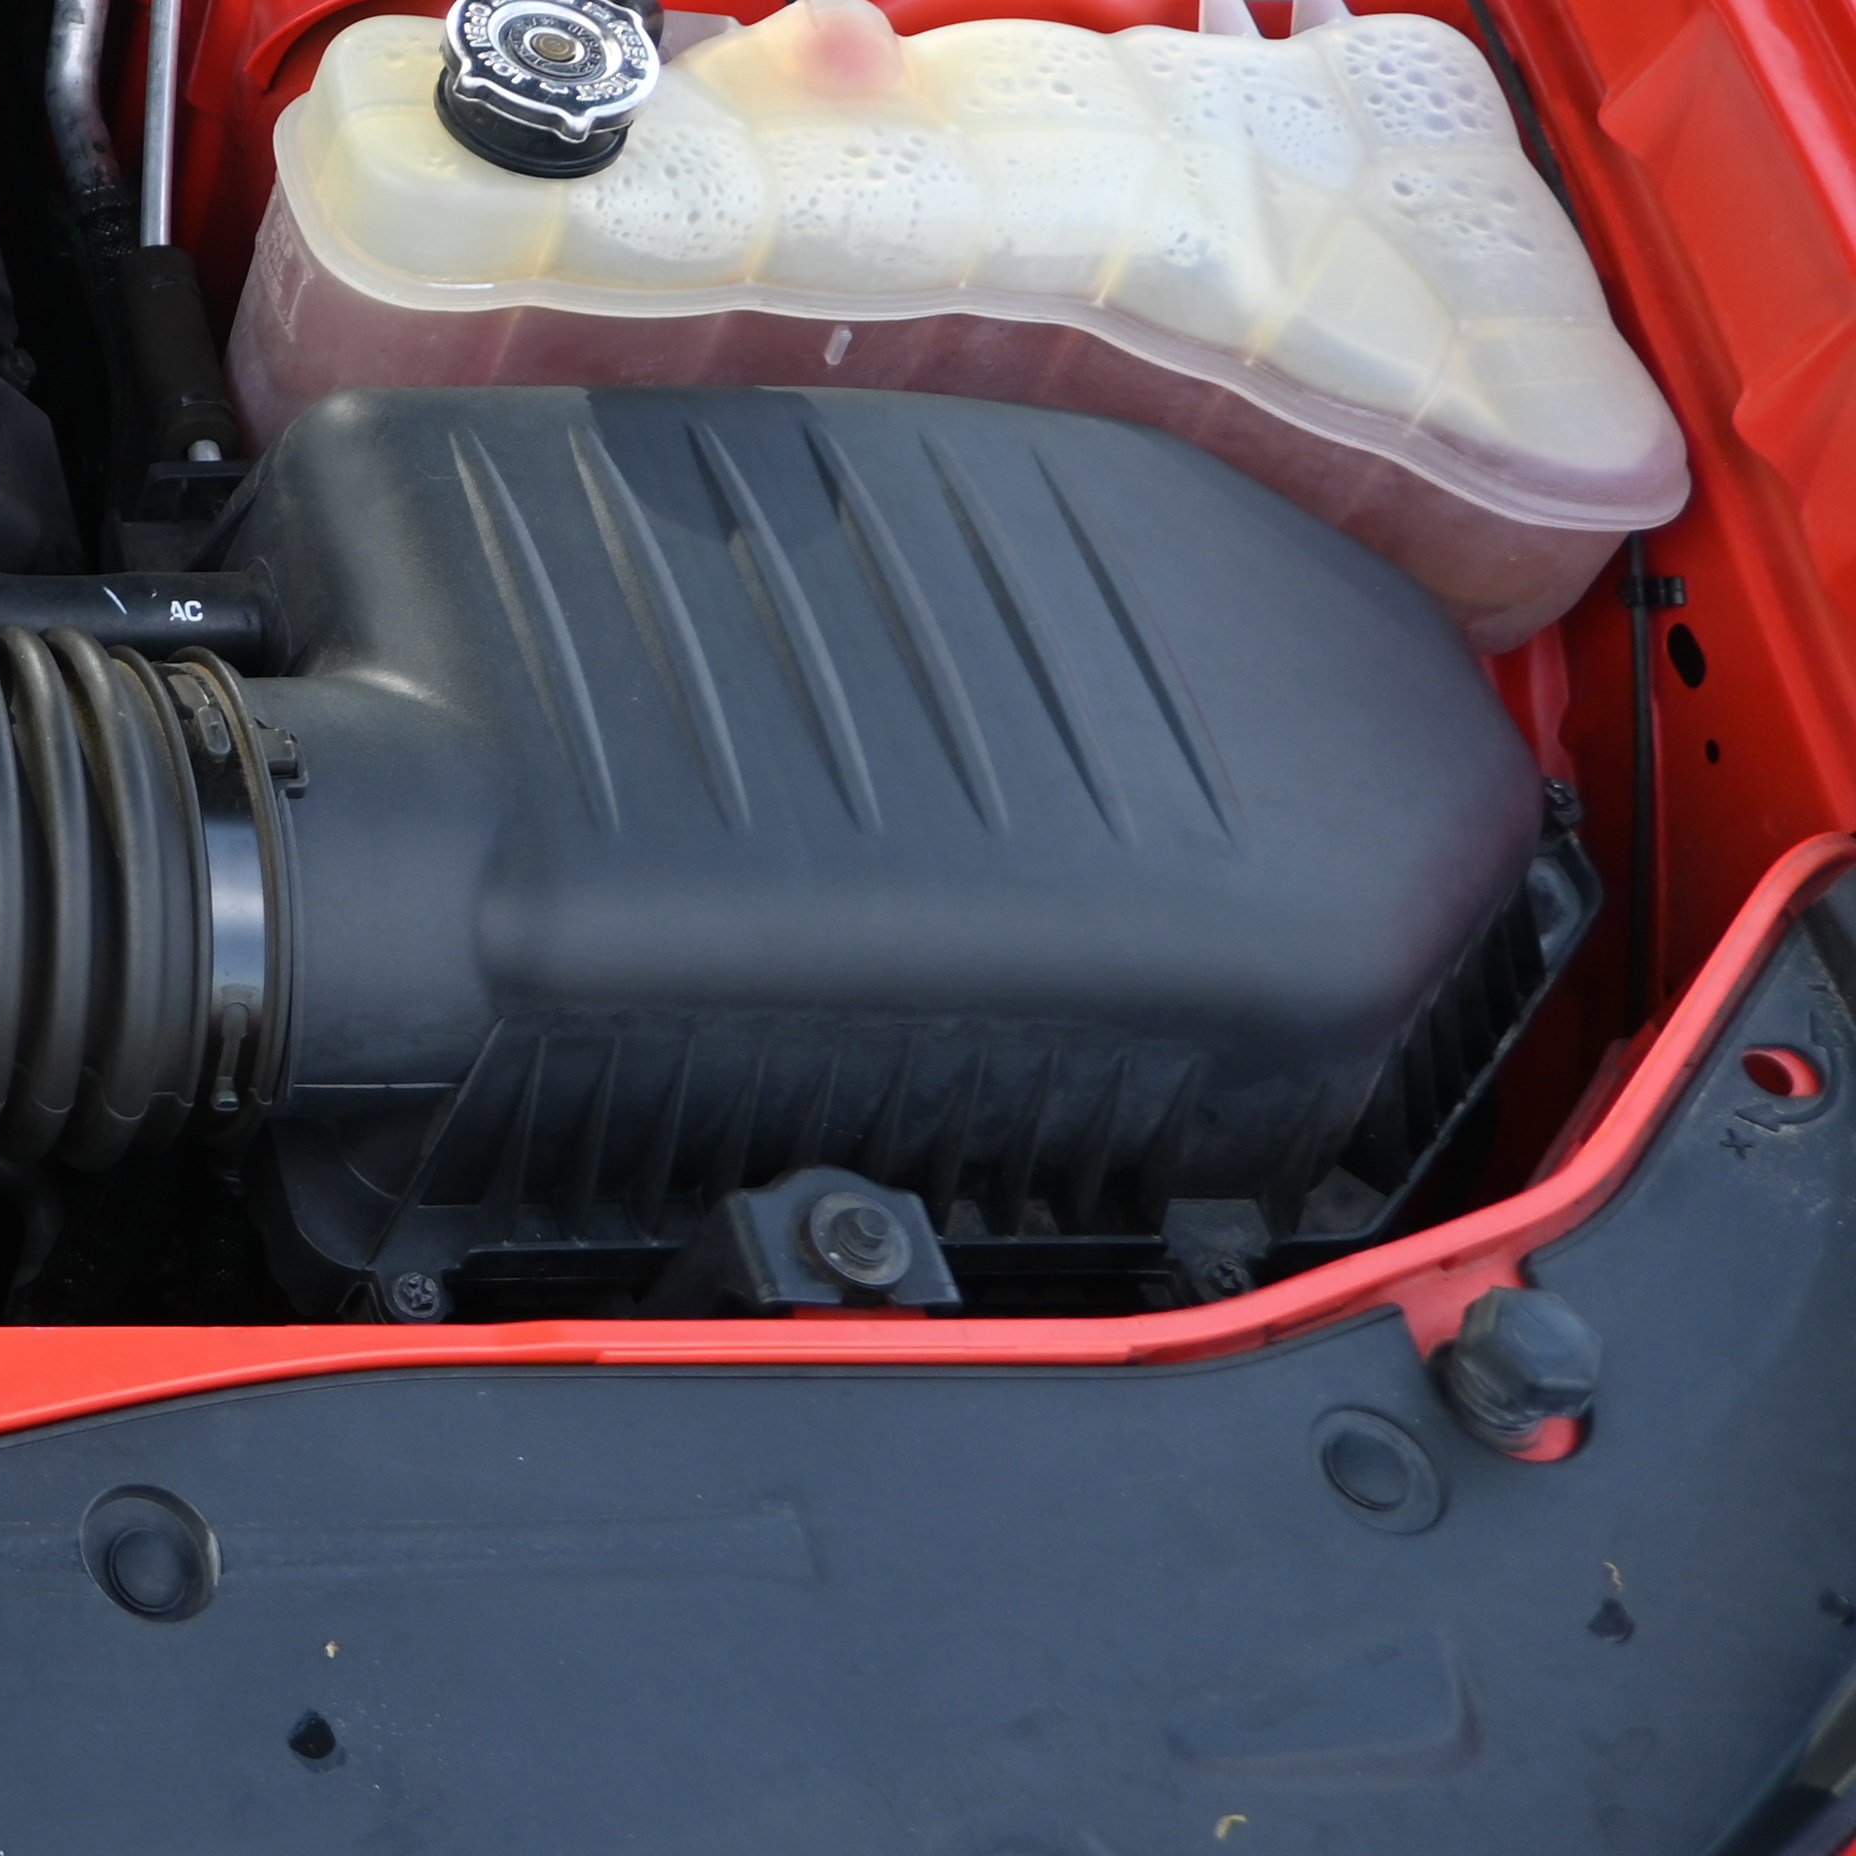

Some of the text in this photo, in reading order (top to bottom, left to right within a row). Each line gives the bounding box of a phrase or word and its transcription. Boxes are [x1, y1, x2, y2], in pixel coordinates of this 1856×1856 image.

[478, 50, 531, 86] HOT
[575, 72, 638, 103] TIGHT
[169, 599, 205, 623] AC
